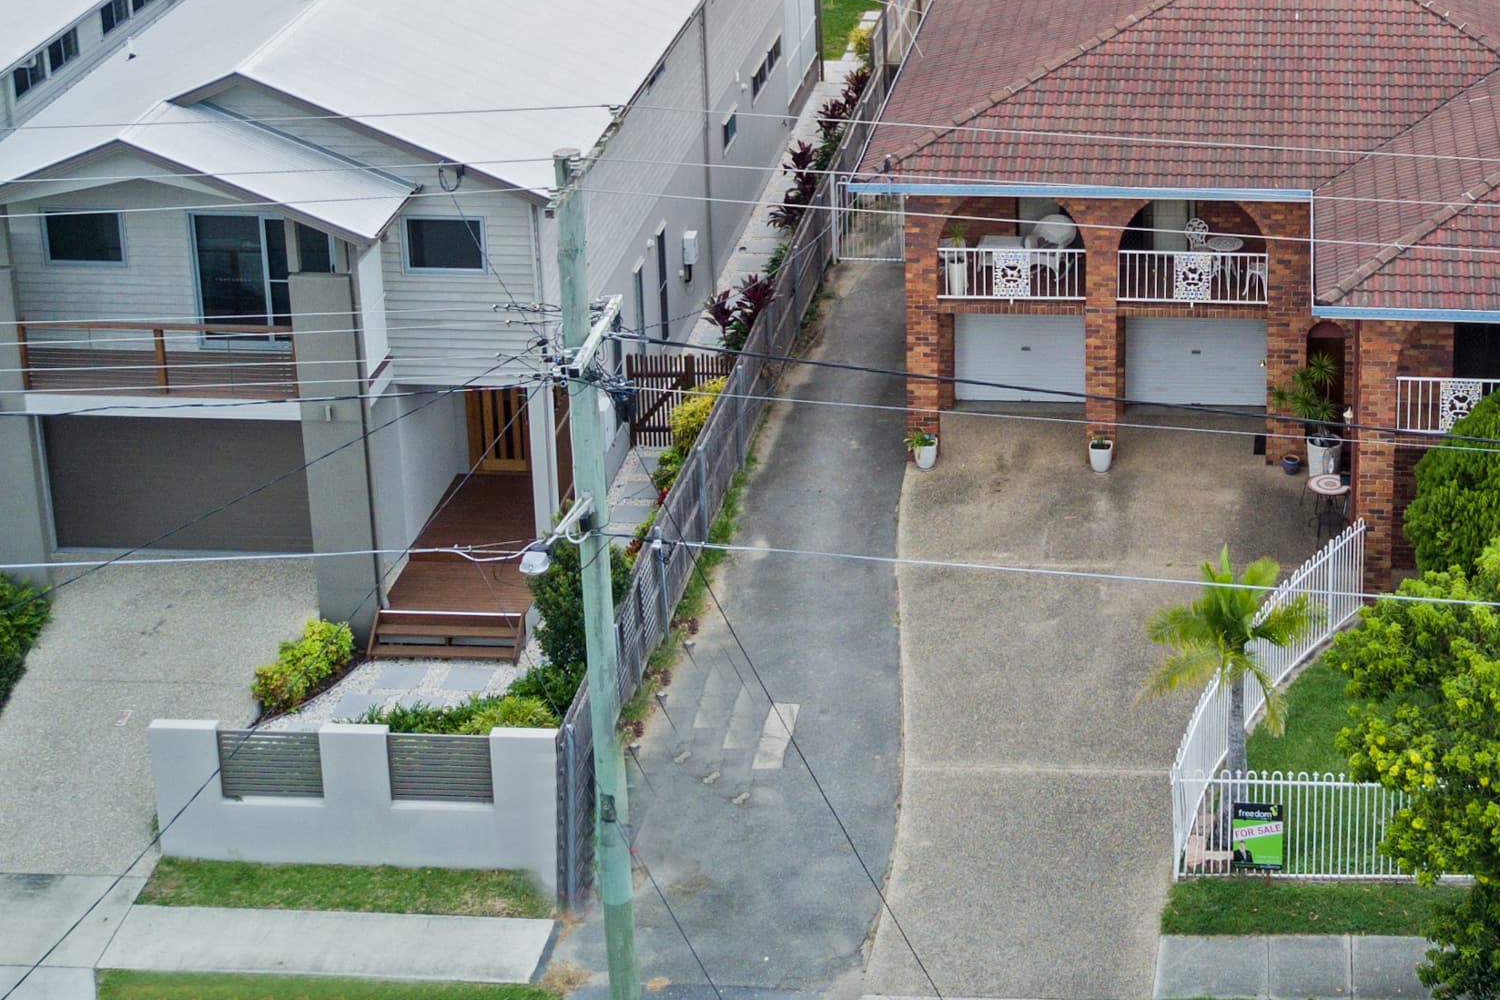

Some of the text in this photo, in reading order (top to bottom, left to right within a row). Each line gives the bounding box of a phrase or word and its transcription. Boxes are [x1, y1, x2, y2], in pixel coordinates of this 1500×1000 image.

[1238, 809, 1272, 818] freedom
[1235, 824, 1281, 838] FOR SALE
